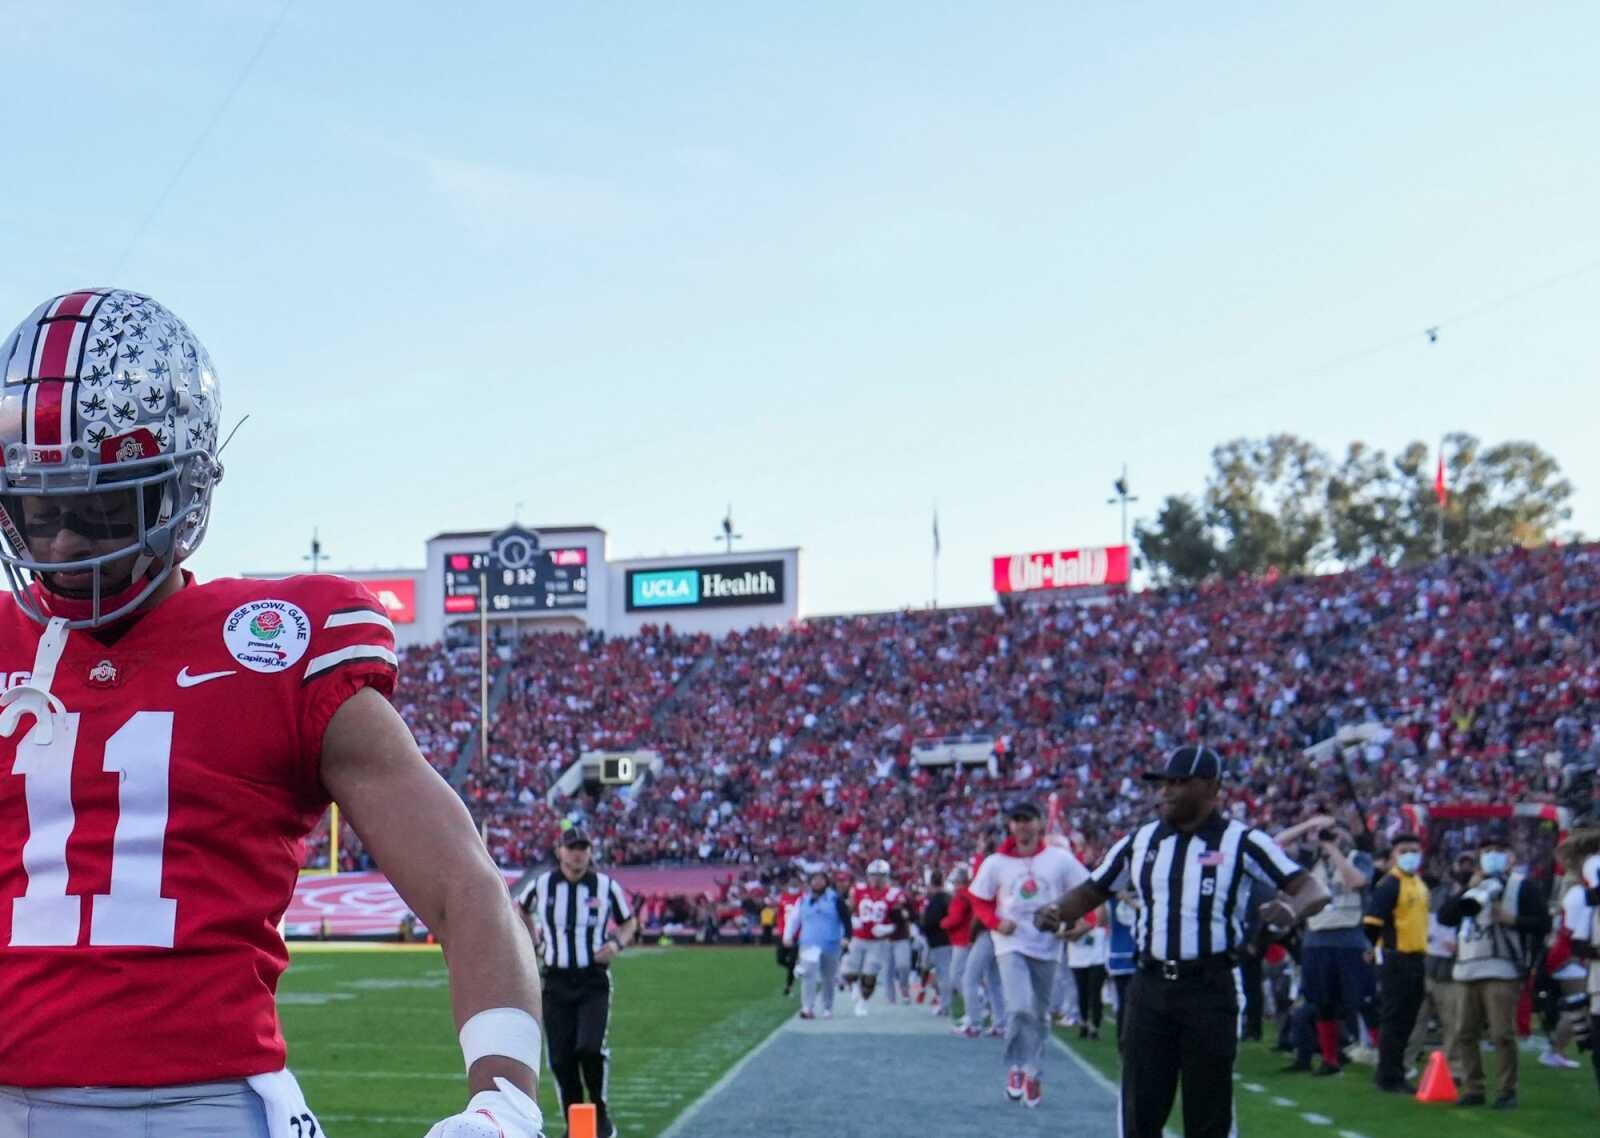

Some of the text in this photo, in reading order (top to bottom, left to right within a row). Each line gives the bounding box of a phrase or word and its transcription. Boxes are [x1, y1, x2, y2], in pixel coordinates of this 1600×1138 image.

[641, 571, 776, 598] UCLA Health
[227, 601, 307, 641] ROSE BOWL GAME
[7, 710, 178, 949] 11
[1201, 877, 1215, 896] S
